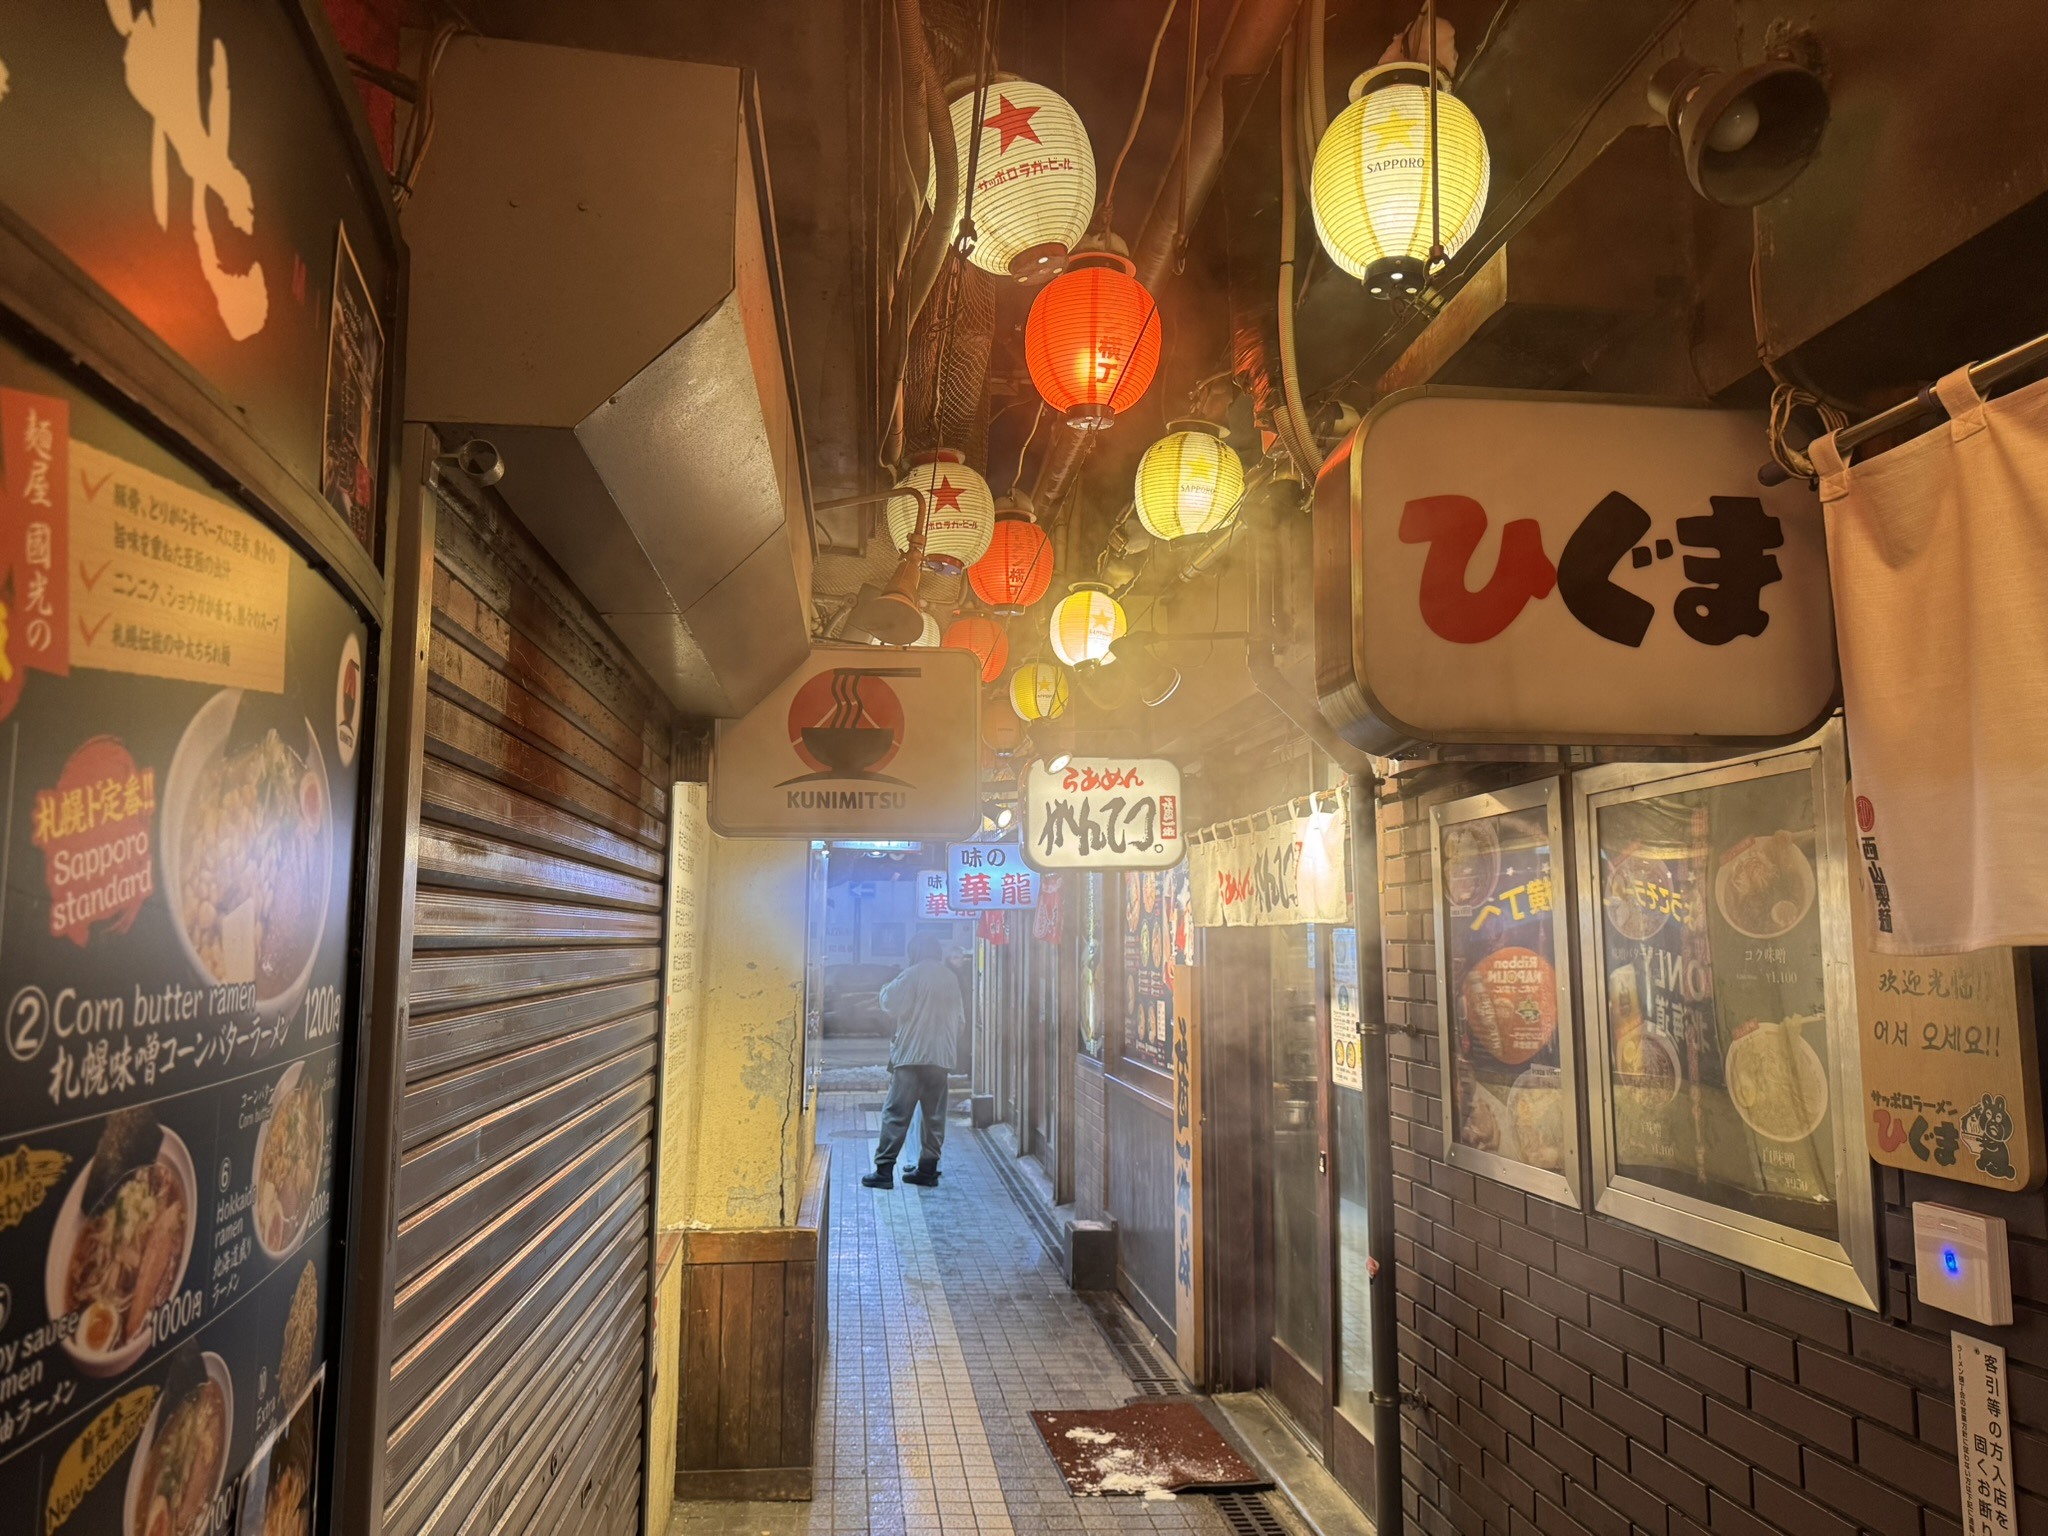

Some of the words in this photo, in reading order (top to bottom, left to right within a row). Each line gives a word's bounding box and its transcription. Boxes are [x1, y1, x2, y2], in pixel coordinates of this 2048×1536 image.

[977, 157, 1073, 192] サッポロラガービール
[1366, 156, 1425, 174] SAPPORO
[24, 408, 53, 507] 麺屋
[1180, 484, 1217, 496] SAPPORO
[927, 518, 979, 531] ポロラガービール
[1399, 490, 1784, 648] ひぐま
[1062, 766, 1145, 793] らあめん
[786, 790, 907, 810] KUNIMITSU
[53, 830, 150, 886] Sapporo
[961, 848, 1006, 868] 味の
[52, 860, 154, 932] standard
[927, 874, 942, 890] 味
[959, 872, 1032, 906] 華龍
[1860, 836, 1893, 934] 西山製麺
[53, 987, 125, 1038] Corn
[133, 982, 203, 1030] butter
[208, 980, 256, 1013] ramen
[1873, 1019, 1909, 1048] 어서
[1920, 1021, 2001, 1058] 오세요!!
[48, 1014, 291, 1106] 札幌味噌コーンバターラーメン
[1870, 1090, 1958, 1116] サッポロラーメン
[1873, 1108, 1961, 1167] ひぐま
[216, 1184, 257, 1225] Hokkaido
[214, 1216, 244, 1250] ramen
[212, 1273, 241, 1309] ラーメン
[22, 1311, 81, 1359] sauce
